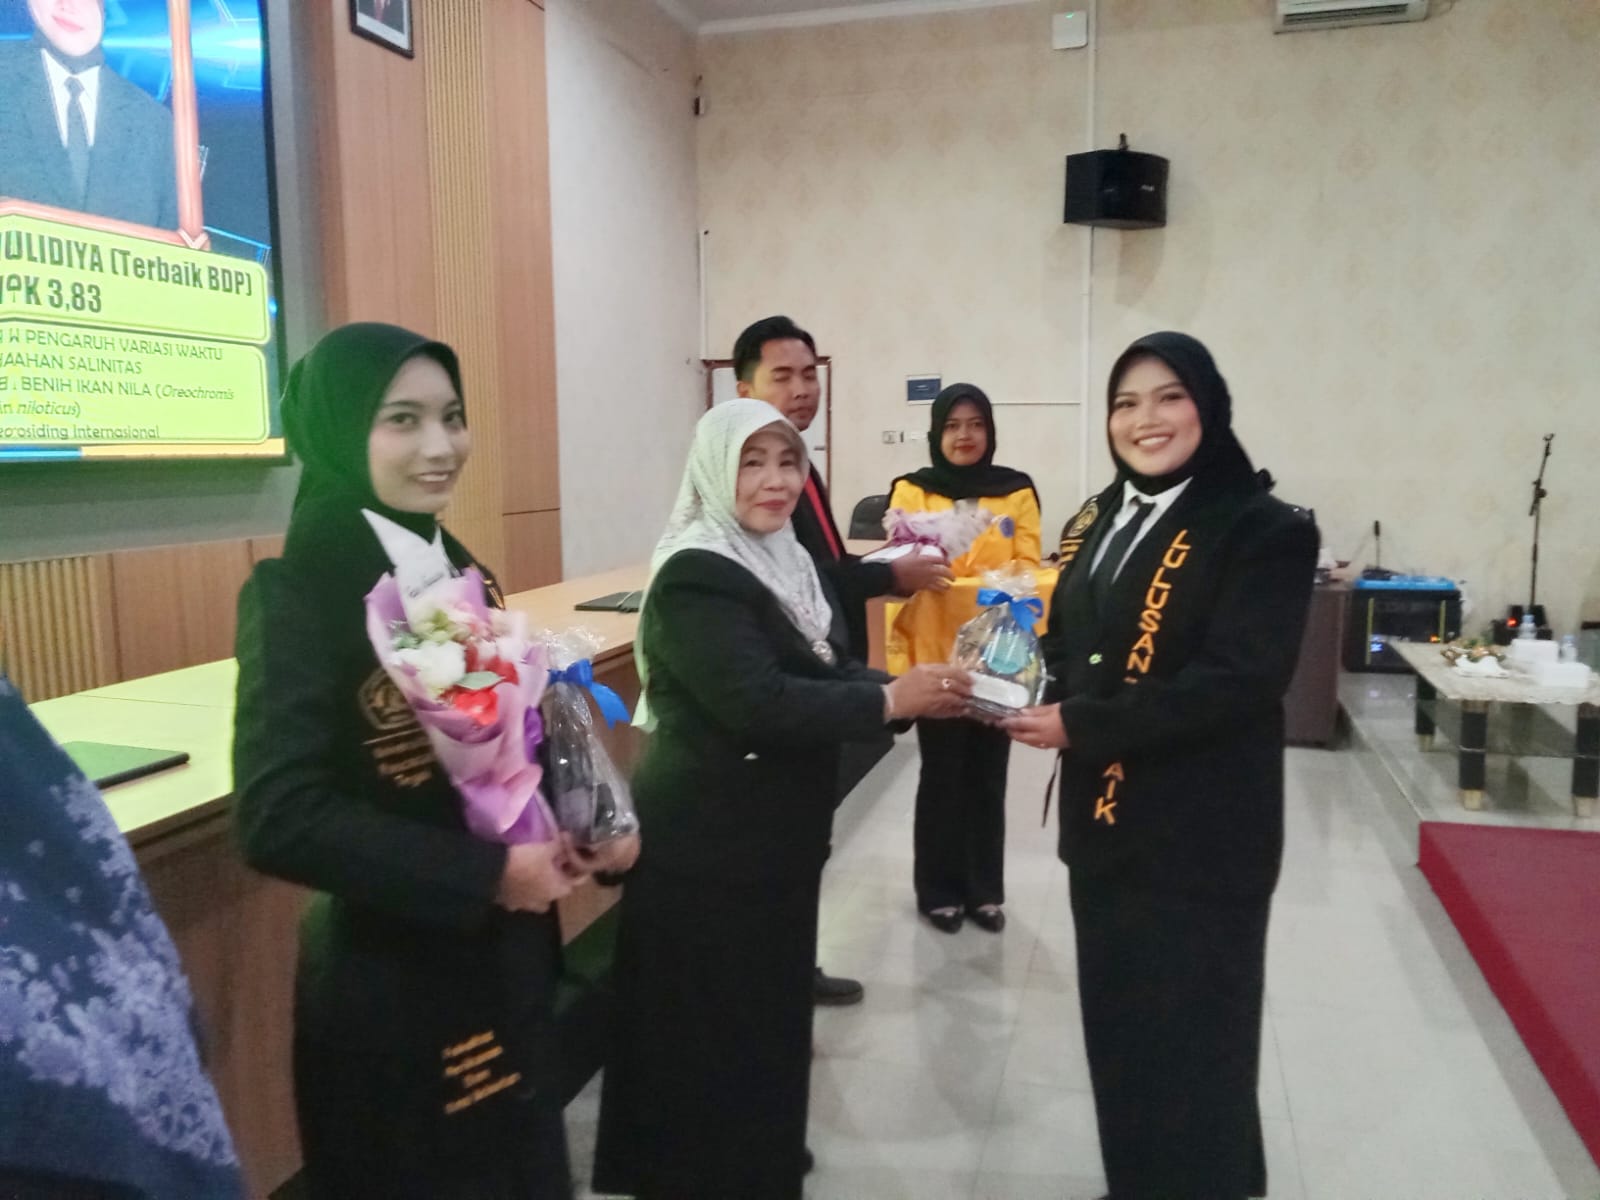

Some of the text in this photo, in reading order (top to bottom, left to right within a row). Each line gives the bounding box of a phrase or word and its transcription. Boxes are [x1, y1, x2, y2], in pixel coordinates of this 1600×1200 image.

[48, 278, 102, 313] 3,83
[25, 329, 115, 351] PENGARUH
[119, 338, 173, 357] VARIASI
[175, 343, 223, 361] WAKTU
[69, 356, 142, 375] SALINITAS
[21, 376, 72, 393] BENIH
[77, 379, 113, 395] IKAN
[118, 381, 152, 396] NILA
[73, 423, 160, 439] Internasional
[1127, 529, 1191, 674] LULUSAN
